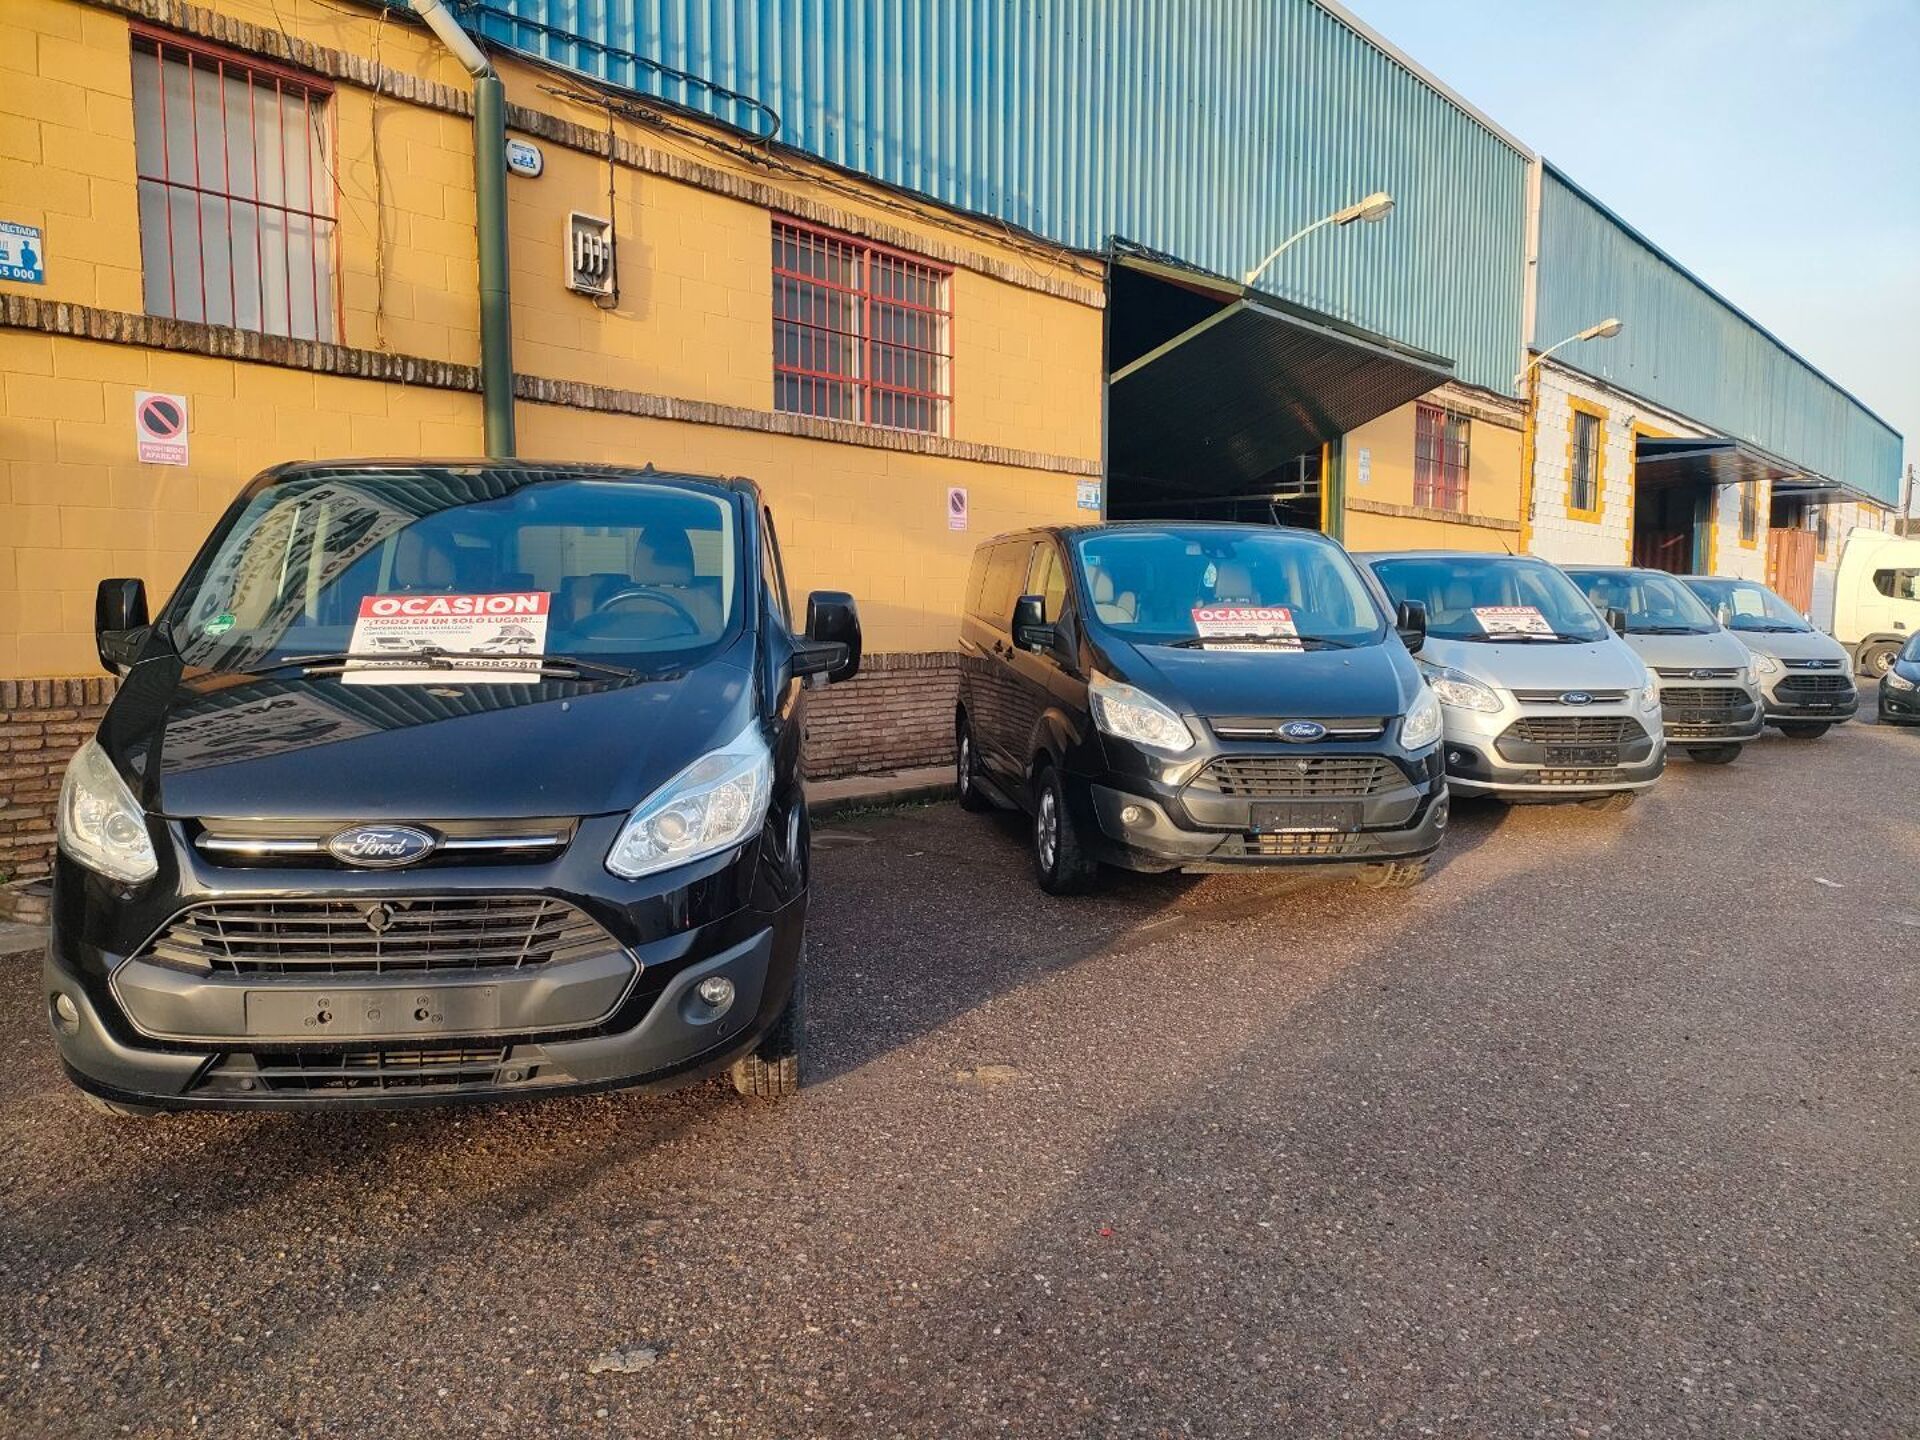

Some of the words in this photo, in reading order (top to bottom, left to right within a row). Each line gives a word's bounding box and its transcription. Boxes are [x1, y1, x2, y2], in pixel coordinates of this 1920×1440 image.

[13, 267, 35, 280] 000
[371, 596, 540, 616] OCASION
[432, 617, 448, 625] UN
[1199, 609, 1286, 620] OCASION
[1290, 723, 1317, 736] Ford
[350, 832, 408, 856] Ford
